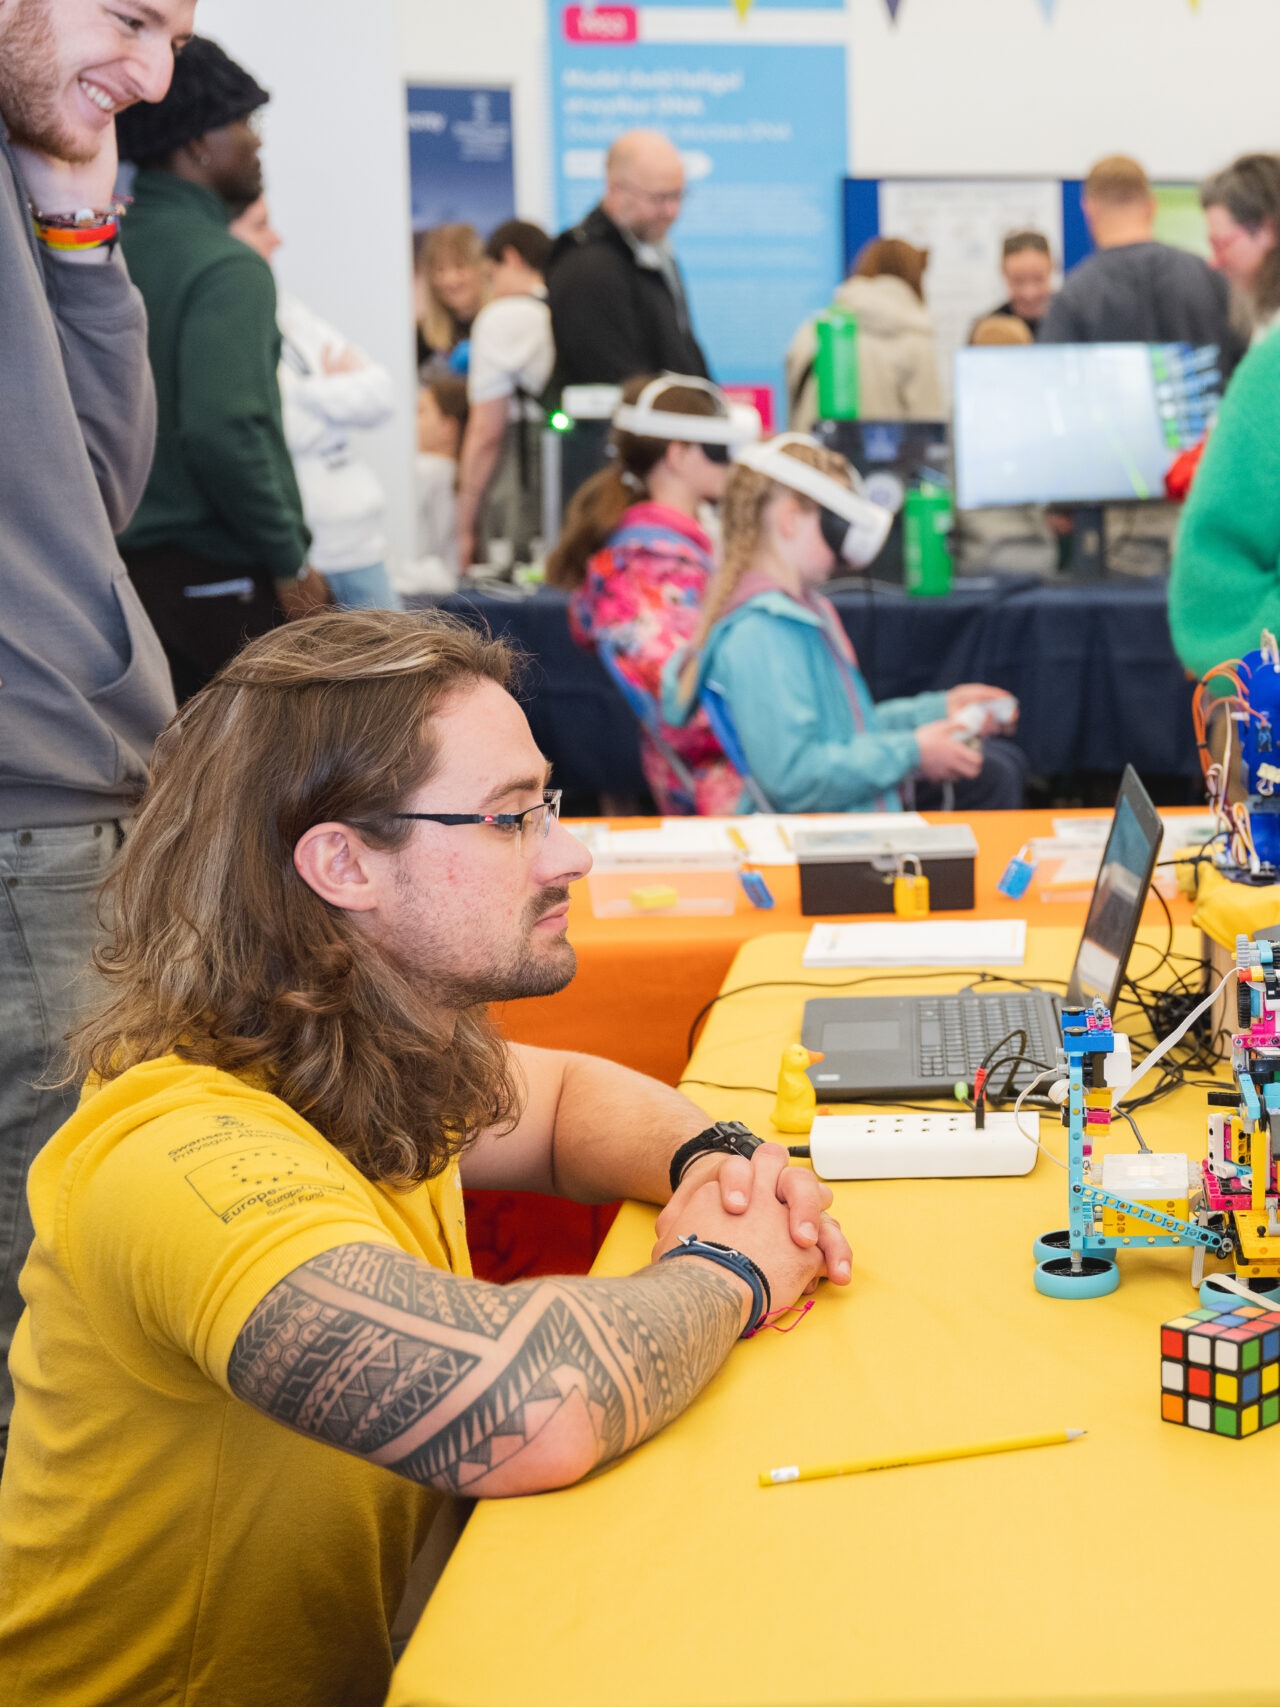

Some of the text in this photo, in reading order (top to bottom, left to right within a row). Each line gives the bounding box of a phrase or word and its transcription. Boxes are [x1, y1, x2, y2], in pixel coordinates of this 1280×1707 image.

[167, 1131, 233, 1157] Swansea
[221, 1184, 278, 1224] Europe
[298, 1190, 325, 1204] Fund
